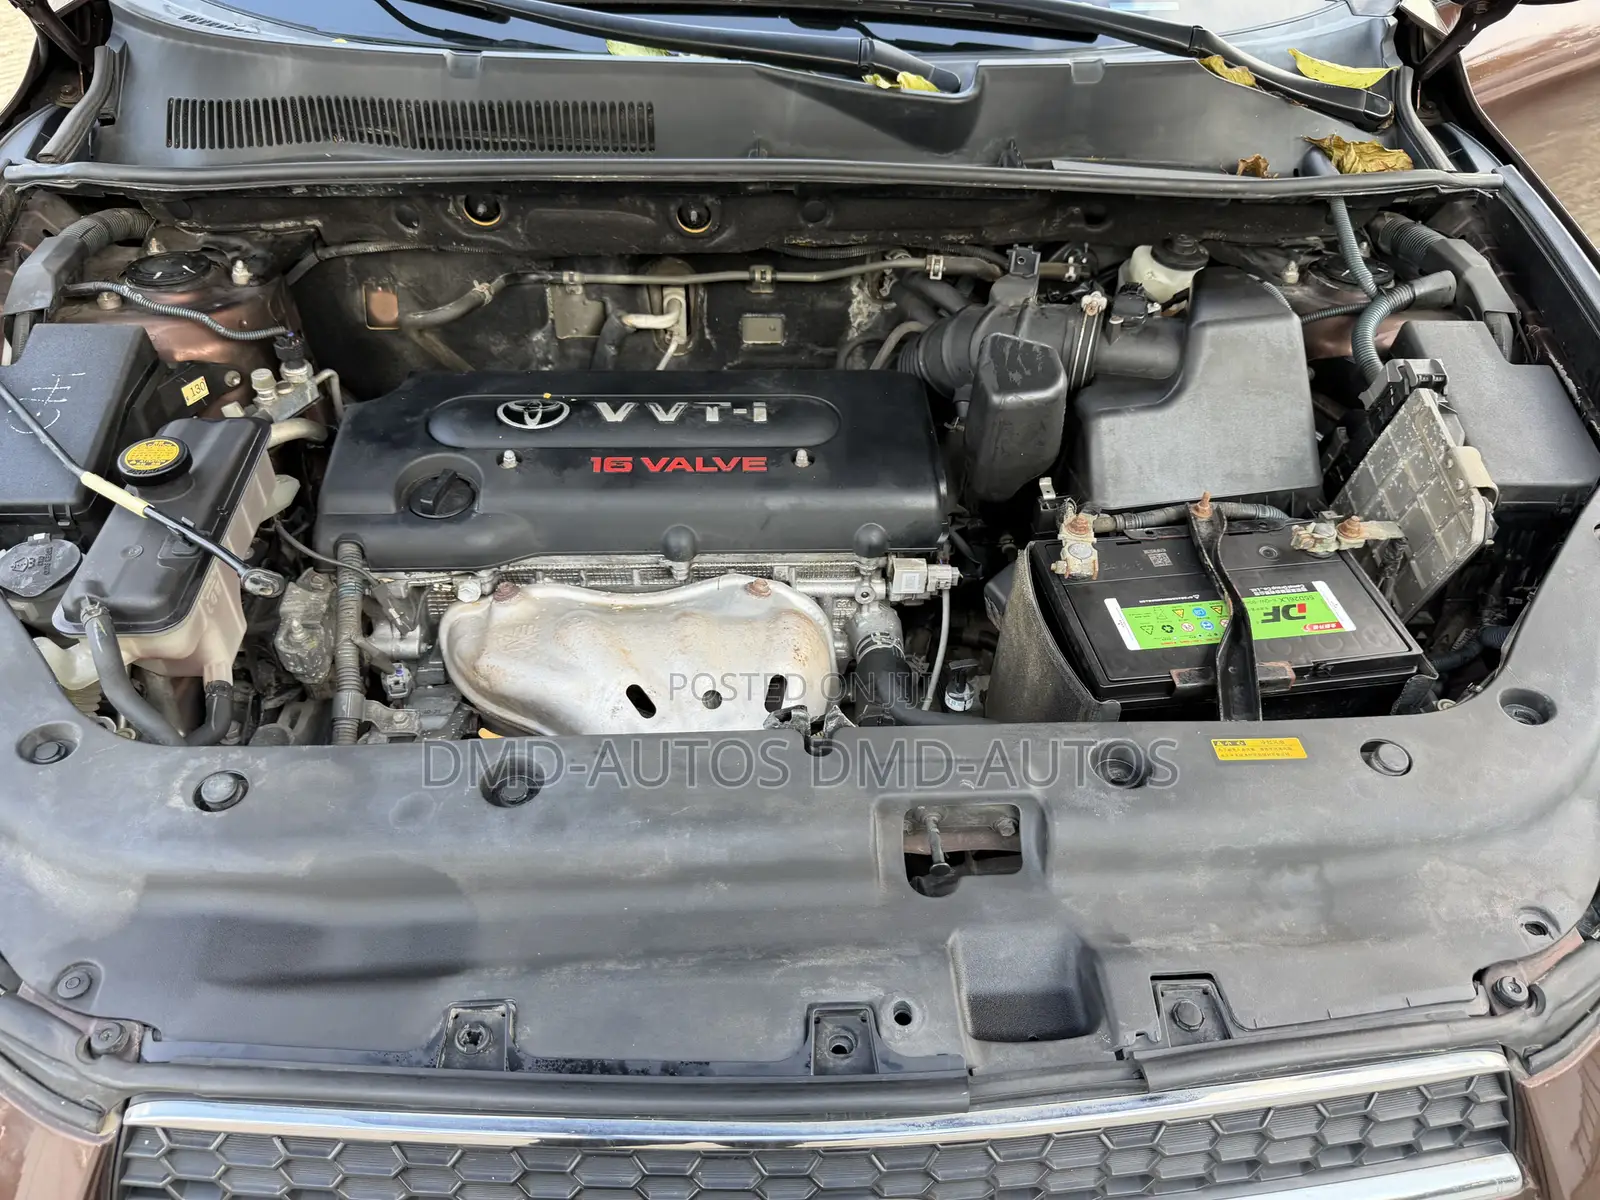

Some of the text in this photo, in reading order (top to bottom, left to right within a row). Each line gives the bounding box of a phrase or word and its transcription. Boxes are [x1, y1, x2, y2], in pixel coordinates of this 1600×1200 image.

[188, 379, 207, 399] 130
[591, 456, 768, 473] 16 VALVE
